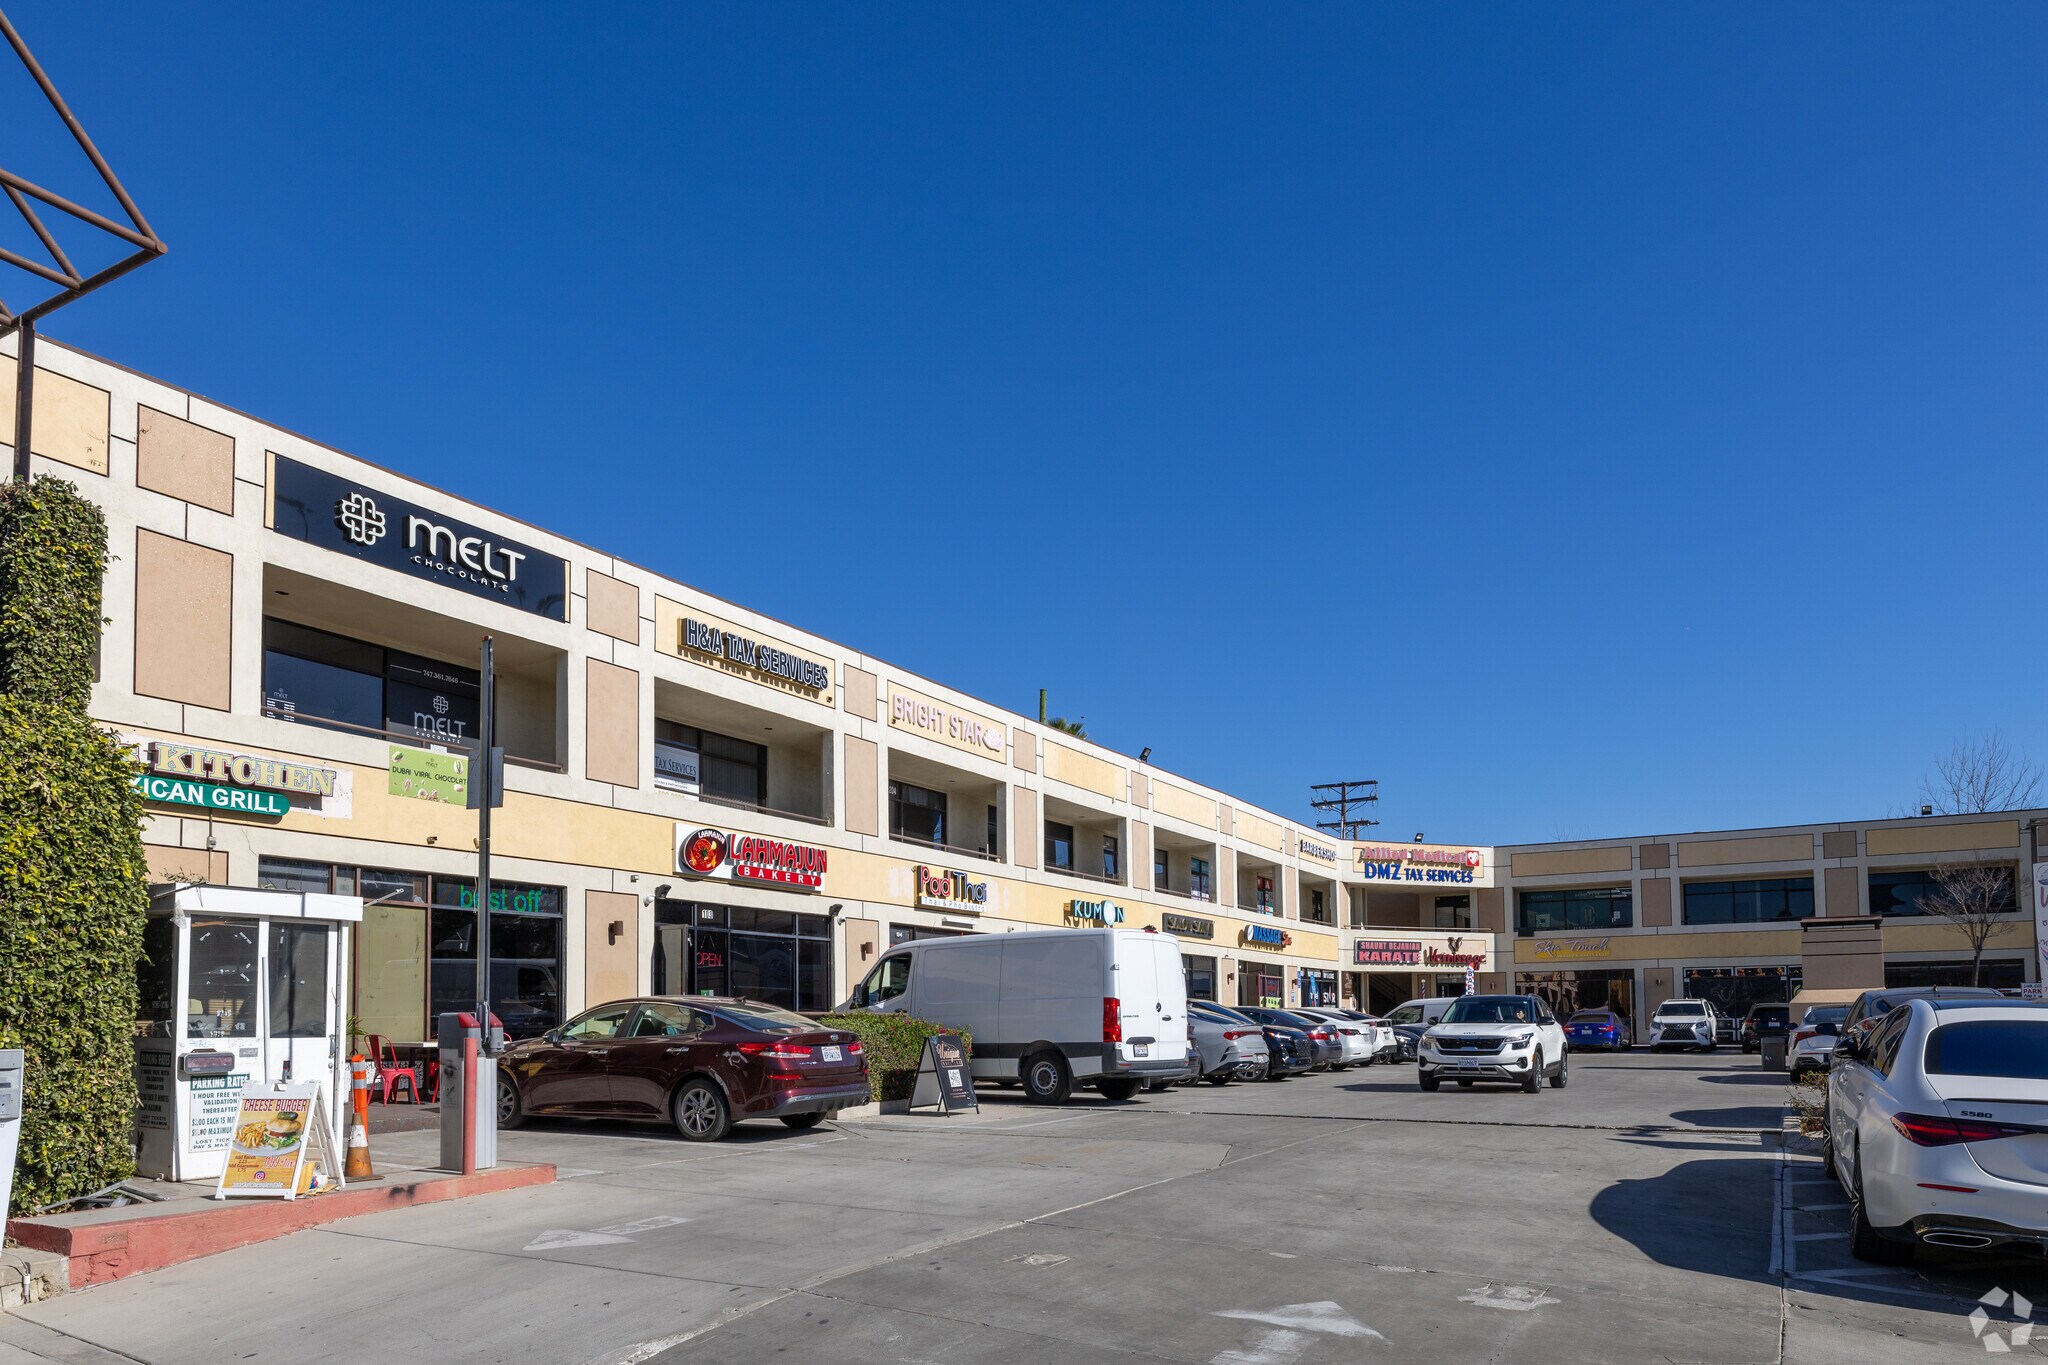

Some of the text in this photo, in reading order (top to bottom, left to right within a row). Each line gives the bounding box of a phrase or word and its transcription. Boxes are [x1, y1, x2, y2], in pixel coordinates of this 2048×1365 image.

[409, 515, 526, 581] MELT
[415, 555, 509, 593] CHOCOLATE
[686, 618, 828, 690] H&A TAX SERVICES
[414, 711, 467, 738] MELT
[893, 694, 982, 747] BRIGHT STAR
[416, 731, 461, 744] CHOCOLATE
[154, 742, 337, 797] KITCHEN
[655, 755, 697, 776] TAX SERVICES
[392, 766, 467, 786] DUBAI VIRAL CHOCOLAT
[211, 788, 282, 814] GRILL
[697, 830, 726, 845] LAHMAJUN
[730, 834, 828, 873] LAHMAJUN
[1363, 846, 1467, 865] Allied Medical
[744, 866, 819, 885] BAKERY
[921, 866, 951, 897] Pad
[1365, 863, 1474, 884] DMZ TAX SERVICES
[460, 884, 541, 913] bst off
[1361, 942, 1387, 950] SHAUNT
[696, 952, 722, 967] OPEN
[1358, 951, 1421, 963] KARATE
[193, 1077, 226, 1090] PARKING
[244, 1099, 307, 1112] CHEESE BURGER
[1960, 1110, 1992, 1118] S580
[207, 1117, 219, 1125] EACH
